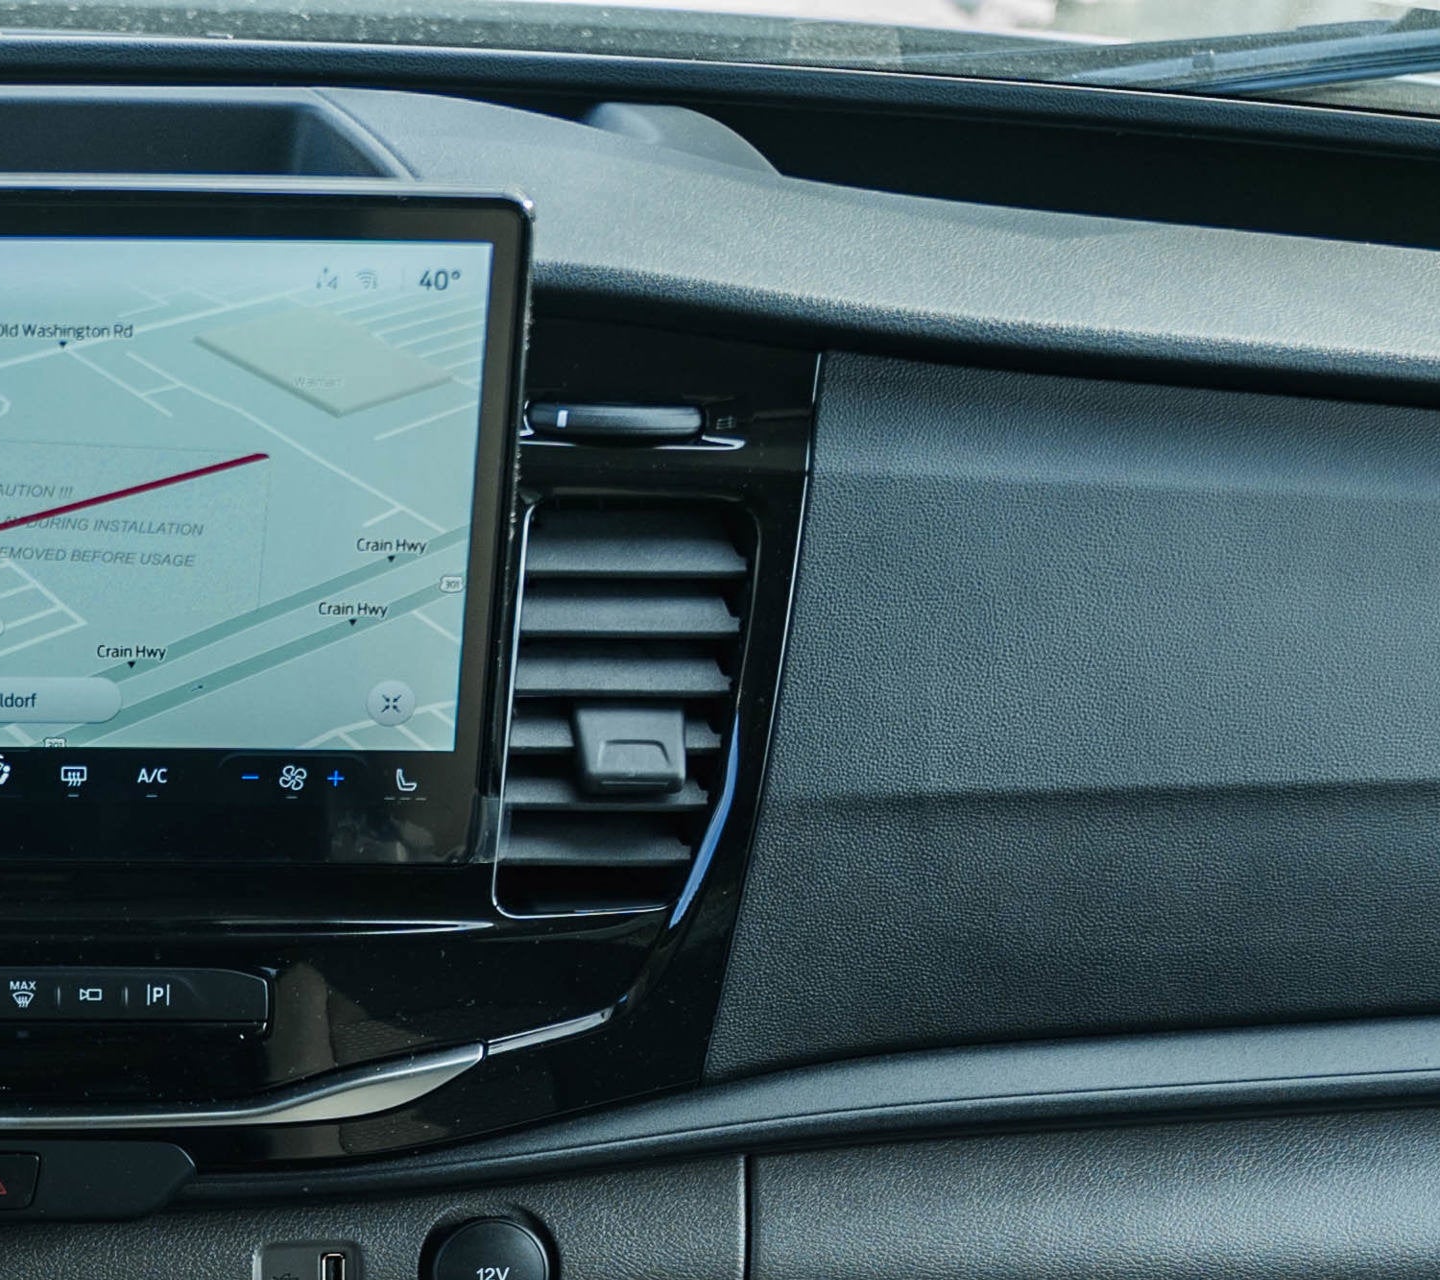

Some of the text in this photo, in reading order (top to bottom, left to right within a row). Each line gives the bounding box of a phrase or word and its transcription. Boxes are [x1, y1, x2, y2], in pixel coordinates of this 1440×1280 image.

[419, 269, 461, 291] 40°
[22, 323, 109, 340] Washington
[113, 324, 133, 338] Rd
[93, 519, 205, 536] INSTALLATION
[356, 537, 428, 554] Crain Hwy
[71, 551, 136, 565] BEFORE
[139, 553, 196, 567] USAGE
[318, 601, 388, 618] Crain Hwy
[96, 645, 166, 662] Crain Hwy
[137, 768, 168, 784] A/C
[9, 980, 37, 991] MAX
